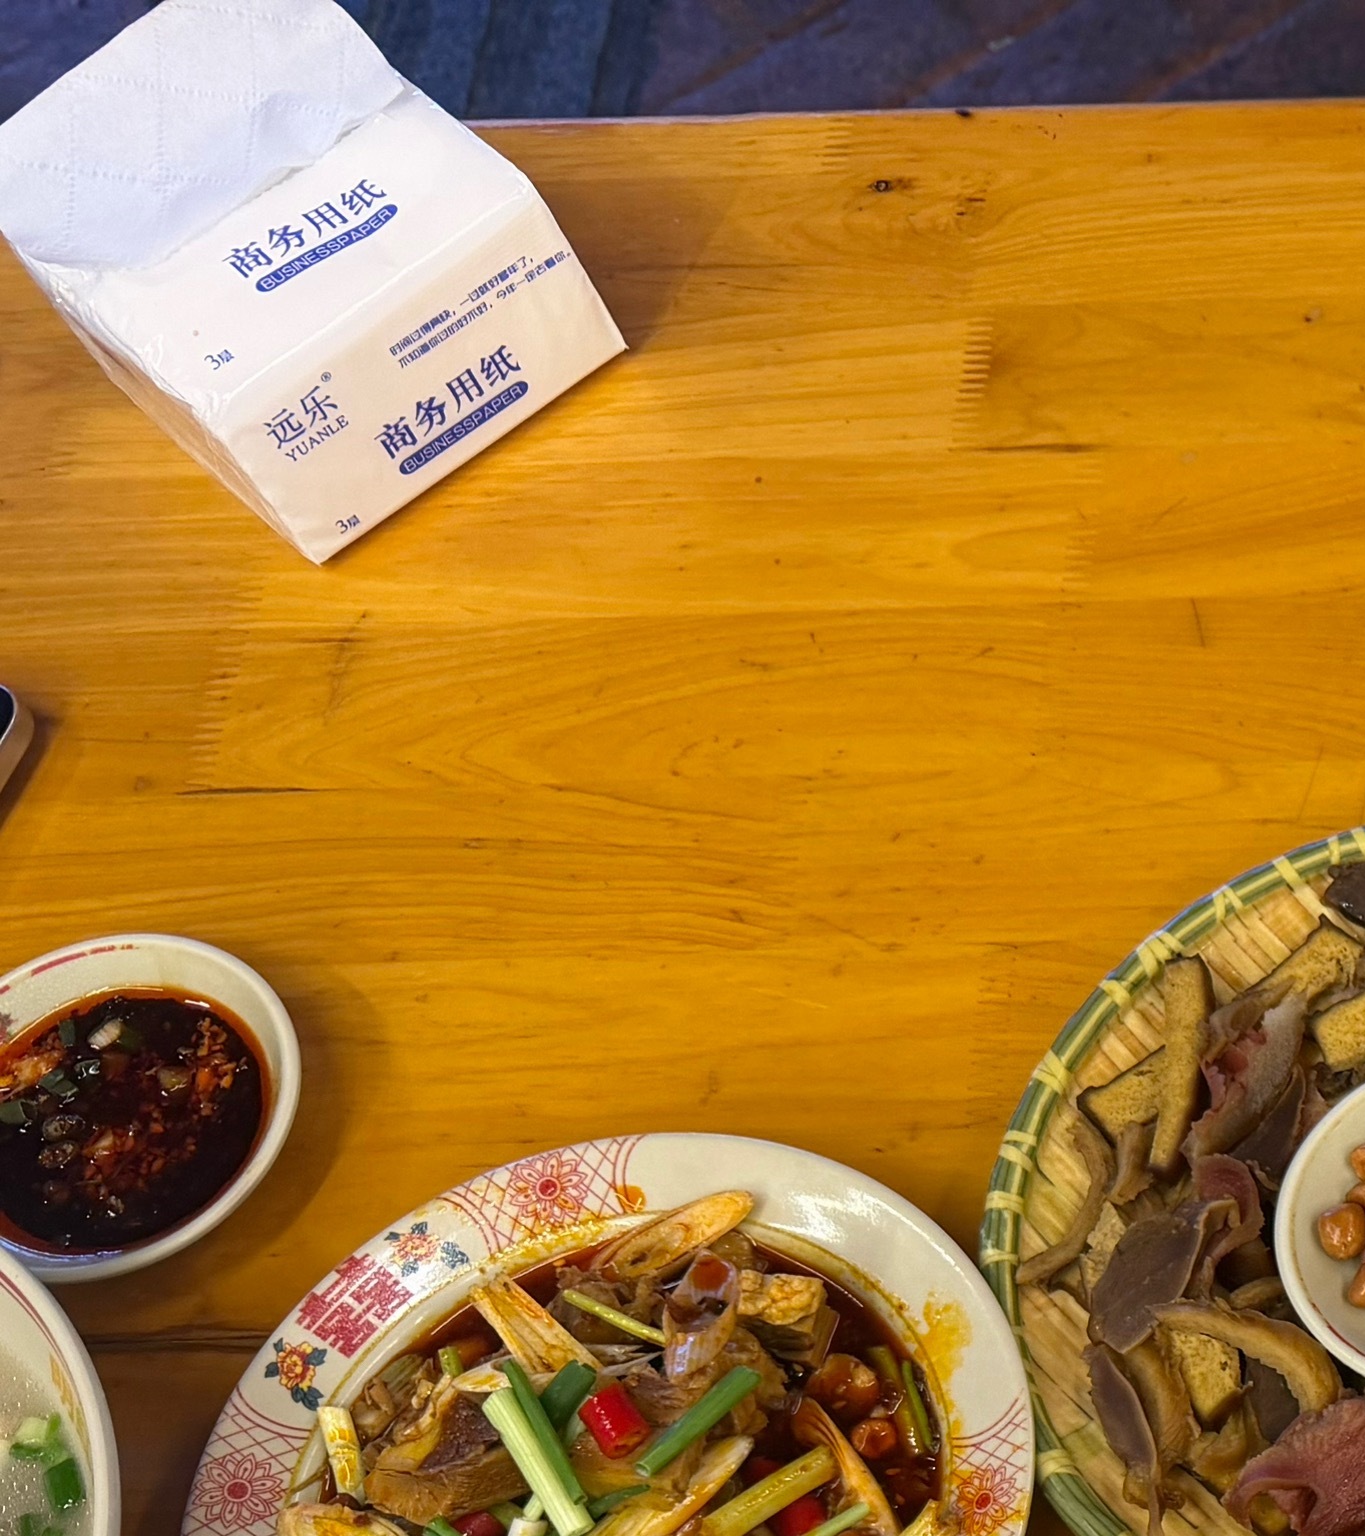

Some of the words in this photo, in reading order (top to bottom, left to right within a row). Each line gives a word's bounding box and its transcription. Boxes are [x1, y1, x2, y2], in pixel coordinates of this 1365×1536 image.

[222, 179, 387, 278] 商务用纸
[259, 208, 393, 291] BUSINESSPAPER
[263, 385, 339, 449] 远乐
[285, 415, 349, 462] YUANLE
[374, 345, 521, 459] 商务用纸
[403, 384, 523, 473] BUSINESSPAPER
